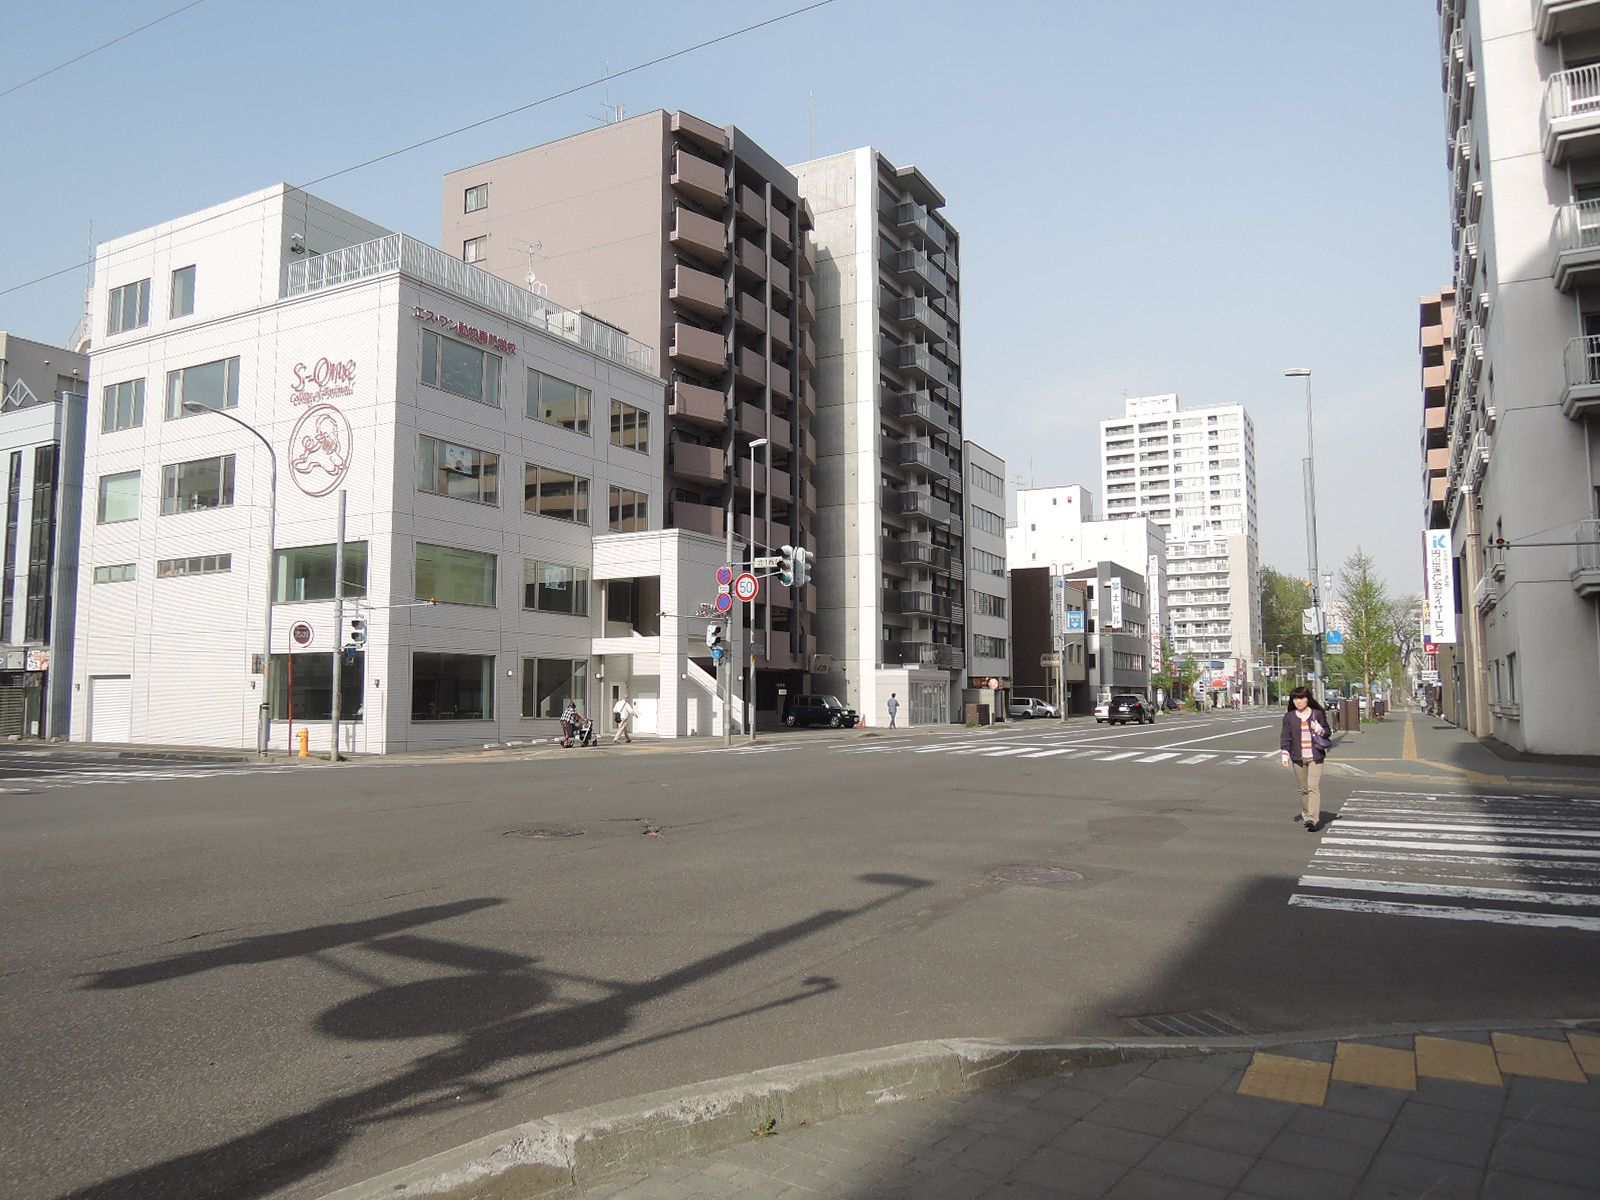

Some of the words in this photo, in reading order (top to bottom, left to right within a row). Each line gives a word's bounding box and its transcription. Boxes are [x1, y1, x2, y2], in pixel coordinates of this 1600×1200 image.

[291, 357, 356, 392] S-One
[739, 581, 753, 594] 50
[1426, 644, 1435, 652] P
